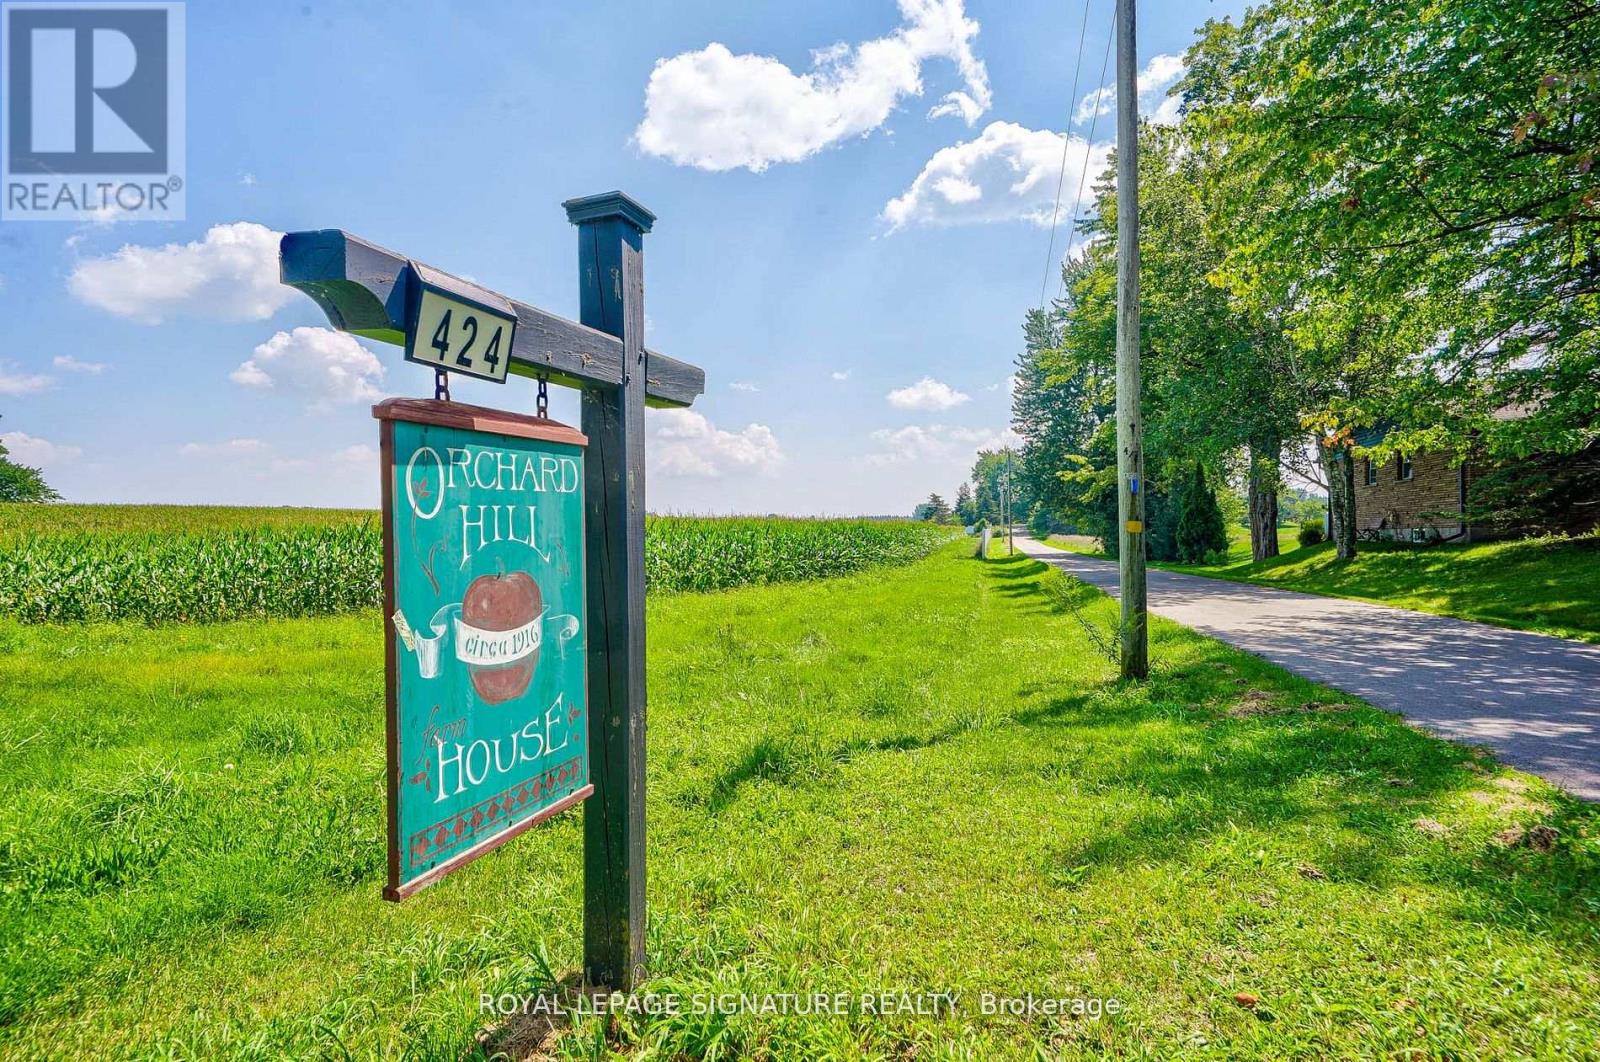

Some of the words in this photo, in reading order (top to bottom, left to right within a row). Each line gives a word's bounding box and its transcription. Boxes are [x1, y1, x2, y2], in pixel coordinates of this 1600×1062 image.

[432, 309, 503, 374] 424
[406, 446, 578, 519] ORCHARD
[459, 504, 551, 571] HILL
[465, 632, 508, 657] circa
[511, 625, 540, 655] 1916
[416, 705, 467, 764] farm
[433, 692, 568, 803] HOUSE
